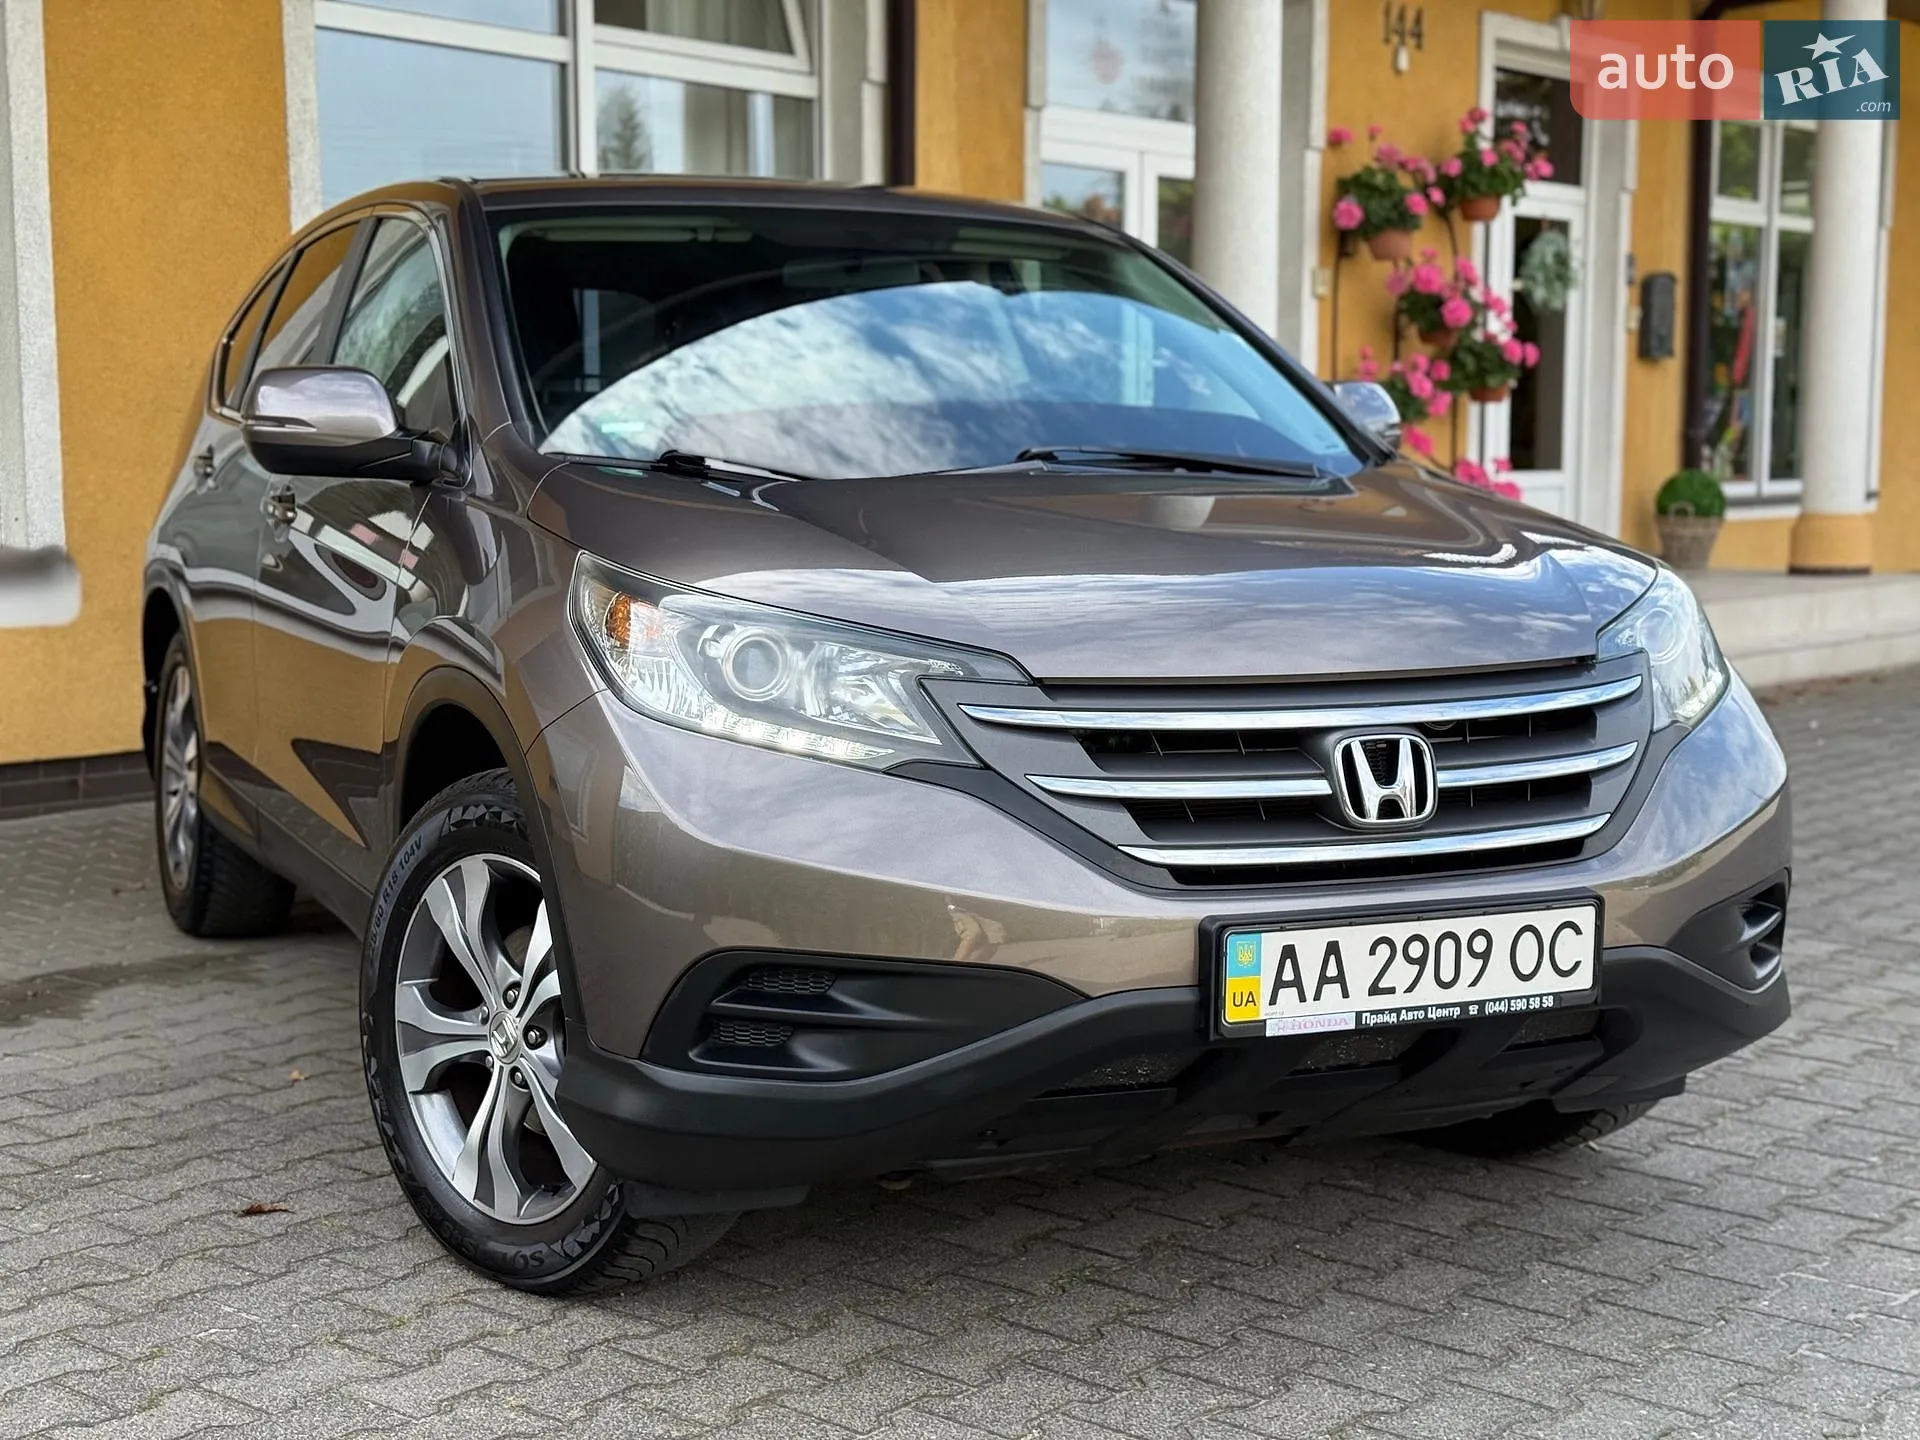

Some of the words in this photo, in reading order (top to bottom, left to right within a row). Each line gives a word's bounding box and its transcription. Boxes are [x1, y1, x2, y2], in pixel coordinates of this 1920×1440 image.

[1384, 0, 1424, 50] 144
[382, 870, 399, 903] R18
[399, 835, 423, 870] 104V
[1268, 940, 1350, 1006] AA
[1367, 928, 1494, 997] 2909
[1509, 920, 1583, 982] OC
[1232, 991, 1256, 1007] UA
[1361, 1012, 1397, 1026] Прайд
[1400, 1009, 1424, 1021] Авто
[1428, 1006, 1460, 1020] Центр
[1485, 999, 1508, 1015] (044)
[1510, 998, 1527, 1011] 590
[1529, 997, 1540, 1009] 58
[1542, 996, 1554, 1008] 58
